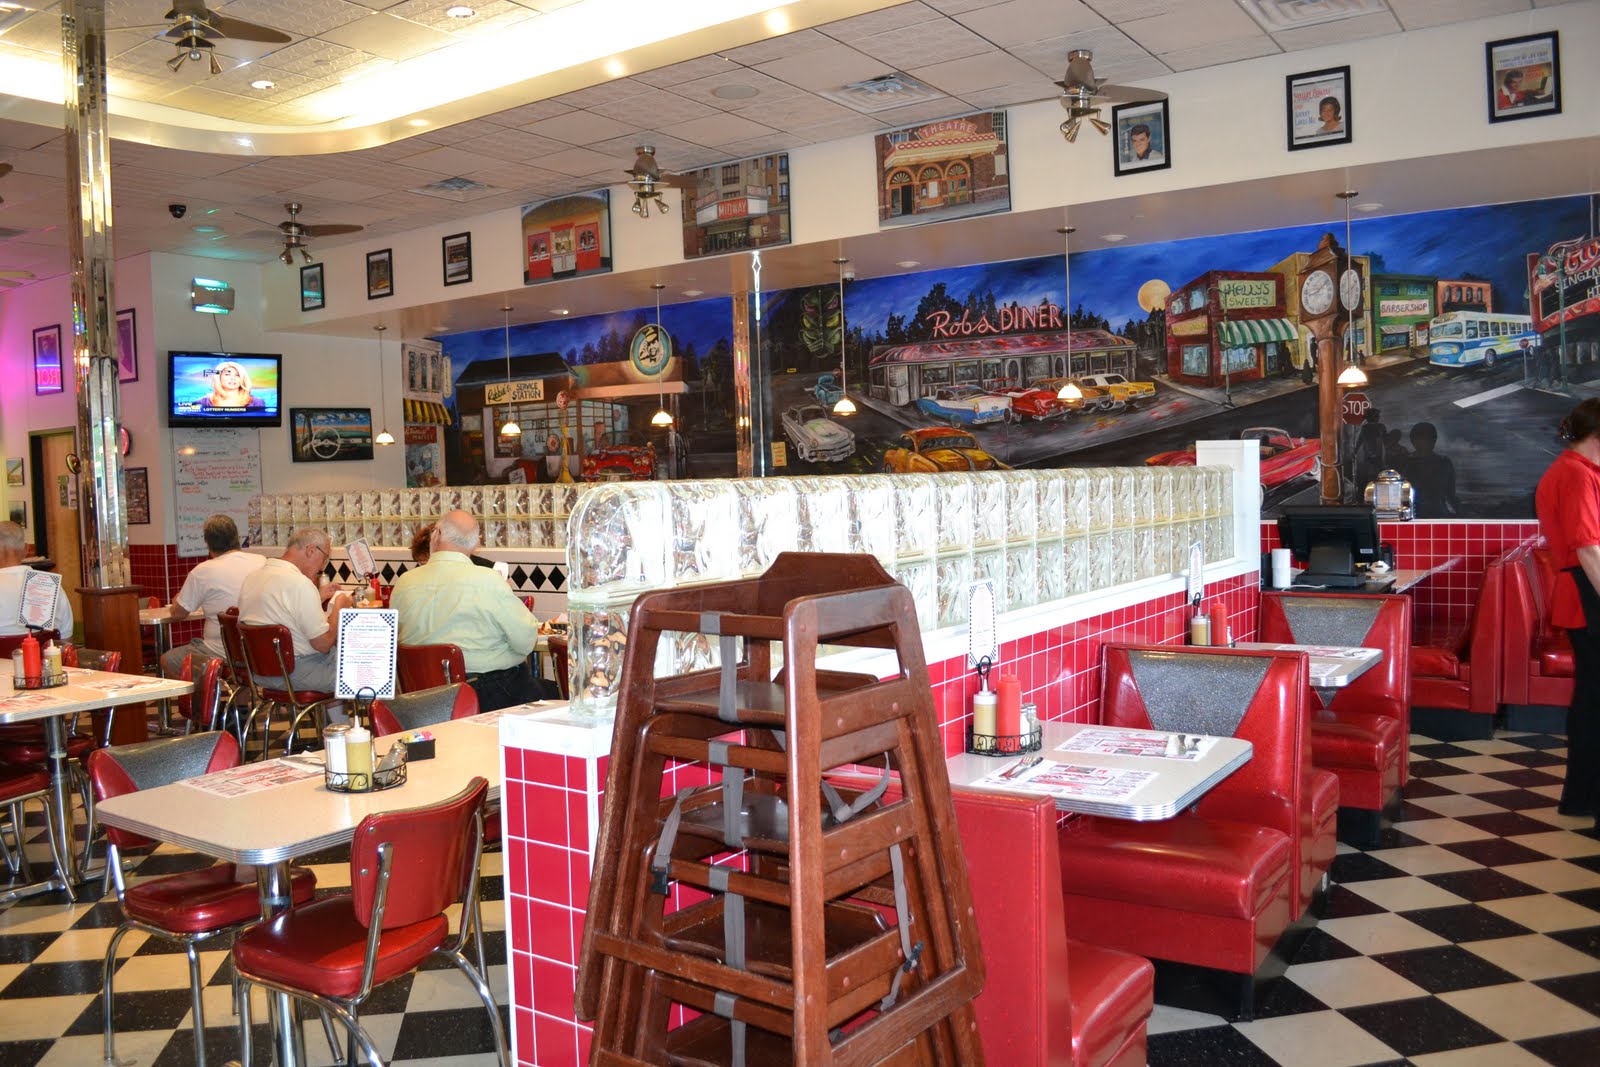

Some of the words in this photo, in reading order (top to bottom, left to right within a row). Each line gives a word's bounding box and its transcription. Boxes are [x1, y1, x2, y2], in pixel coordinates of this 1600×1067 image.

[923, 121, 973, 137] THEATRE
[718, 201, 747, 217] MIDWAY
[1229, 296, 1269, 306] SWEETS
[1381, 303, 1410, 314] BARBER
[1410, 302, 1428, 312] SHOP
[1001, 303, 1063, 331] DINER
[516, 382, 538, 391] SERVICE
[512, 389, 542, 401] STATION
